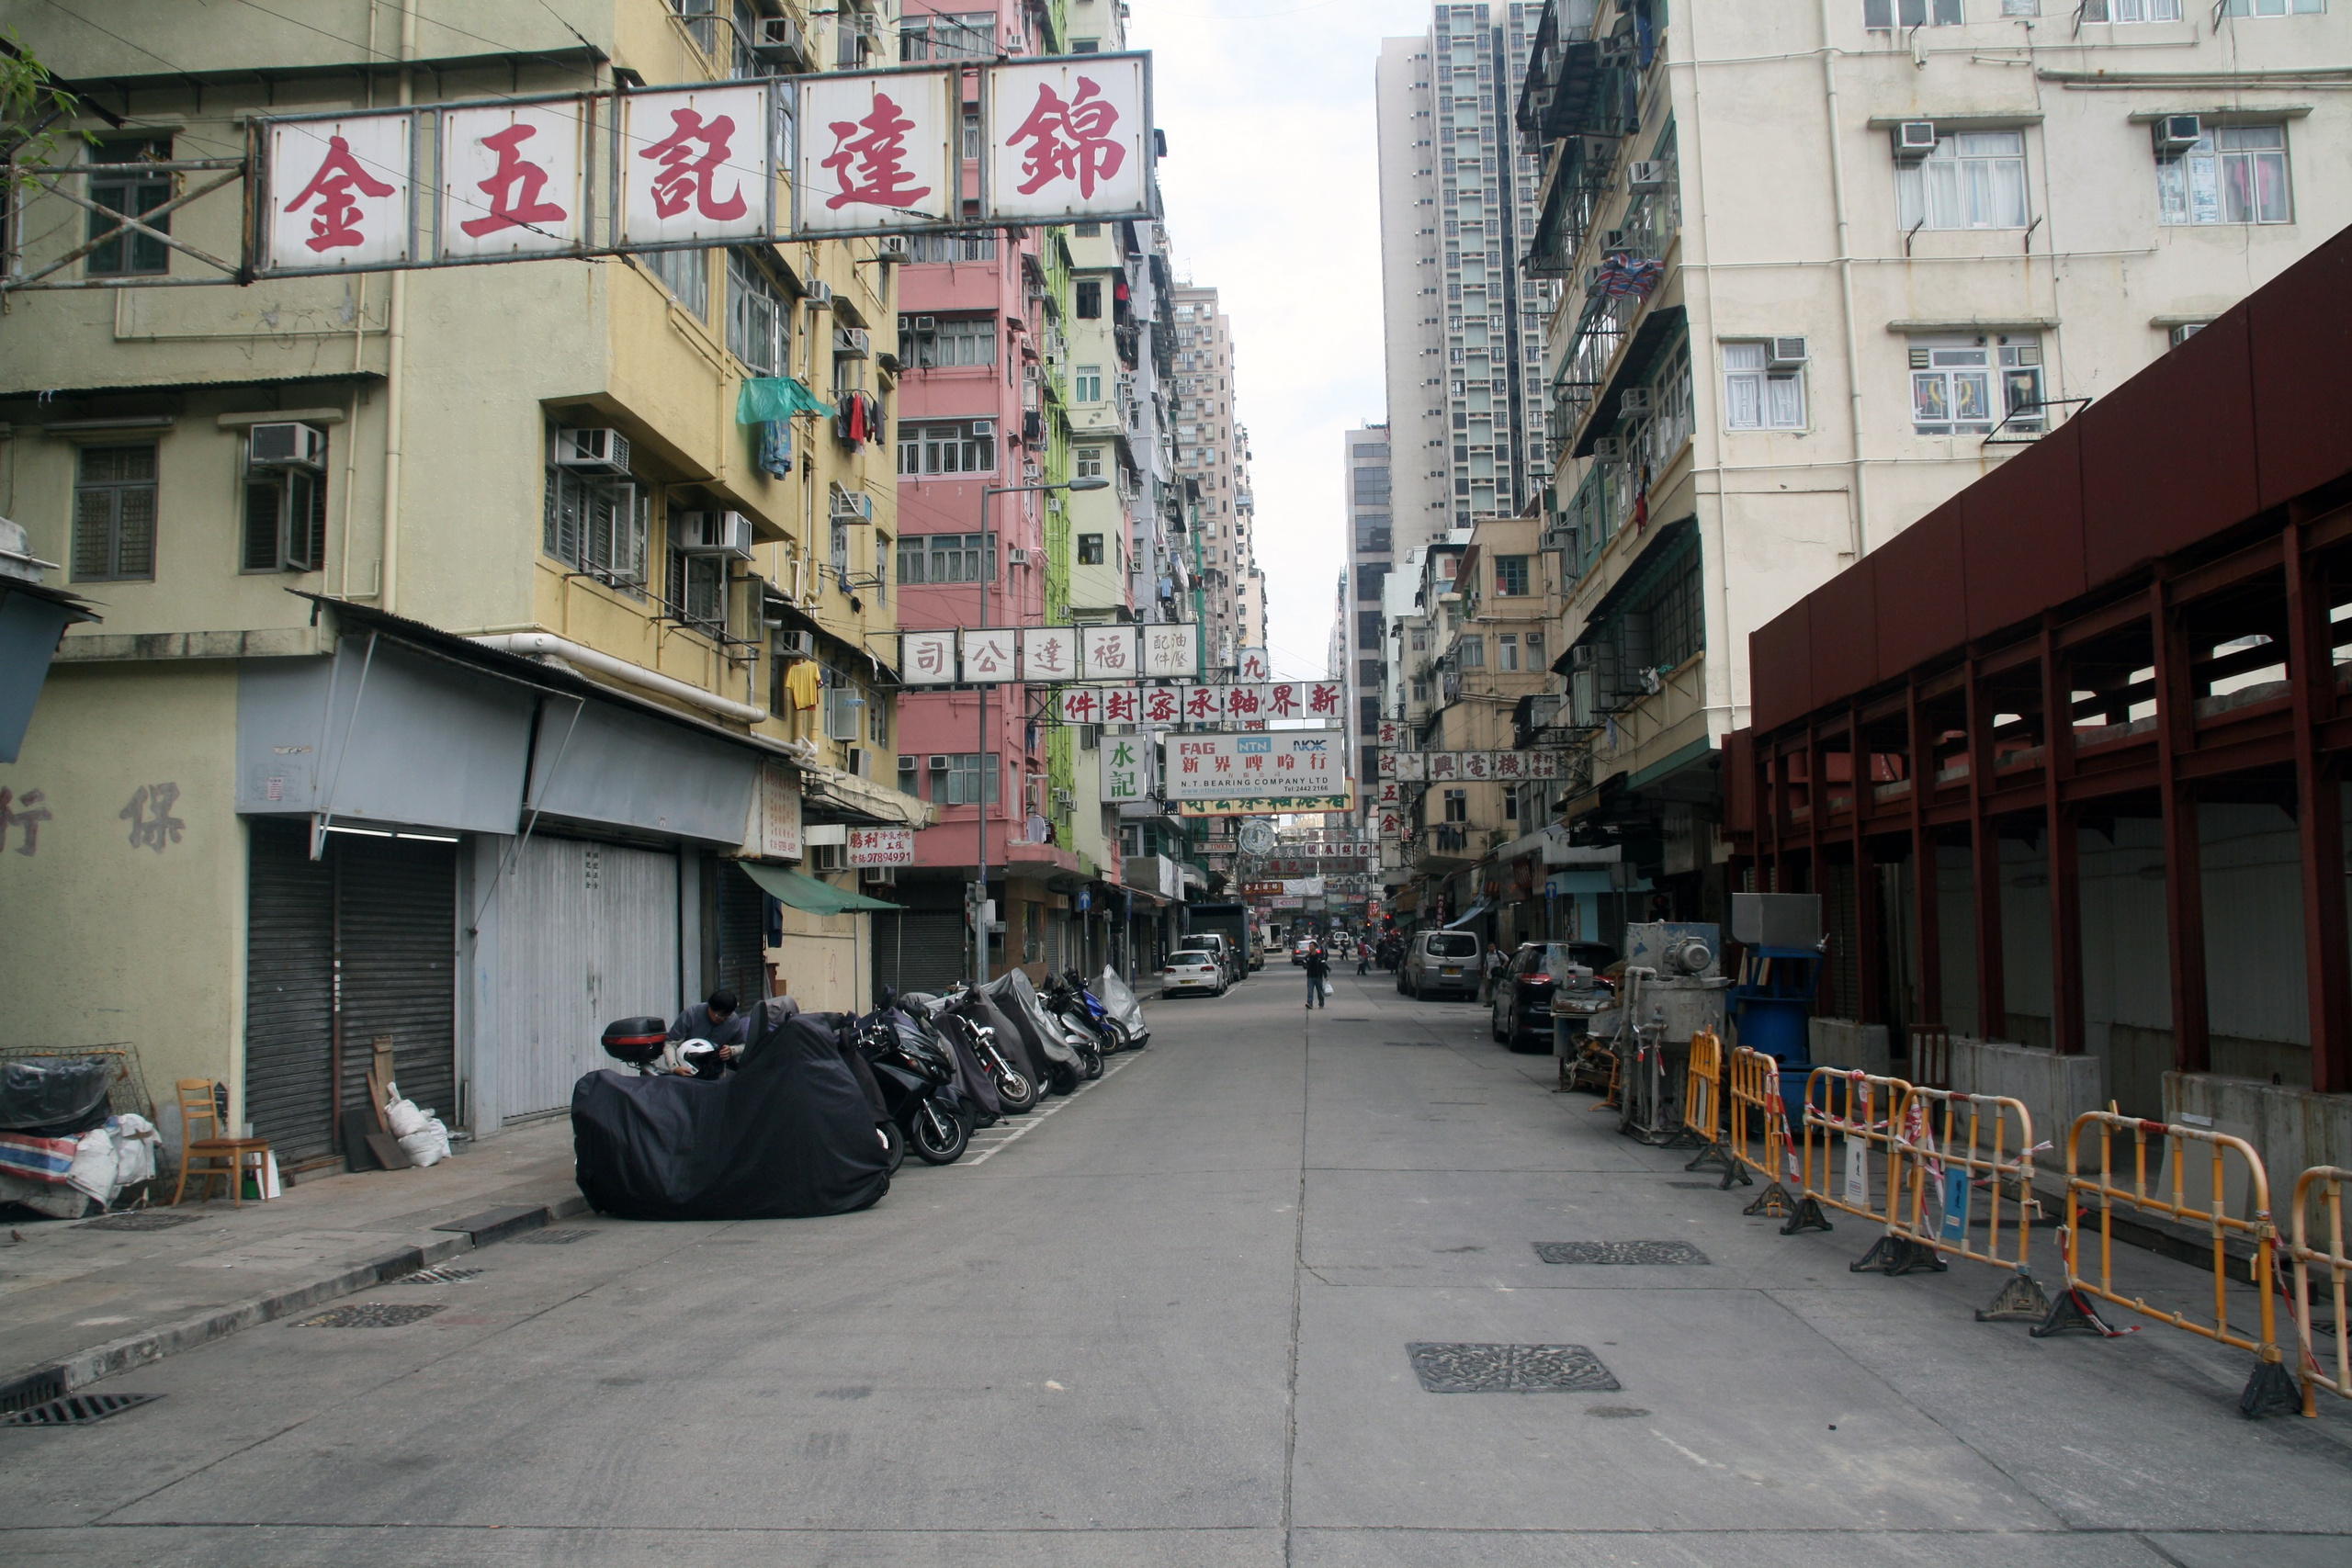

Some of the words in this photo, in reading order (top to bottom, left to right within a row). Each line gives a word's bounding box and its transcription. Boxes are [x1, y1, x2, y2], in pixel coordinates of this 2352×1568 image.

[1180, 742, 1216, 755] FAG
[1293, 739, 1328, 751] NOK
[1109, 740, 1137, 798] 水記
[1254, 777, 1306, 785] COMPANY
[1181, 786, 1263, 795] www.ntbearing.com.hk
